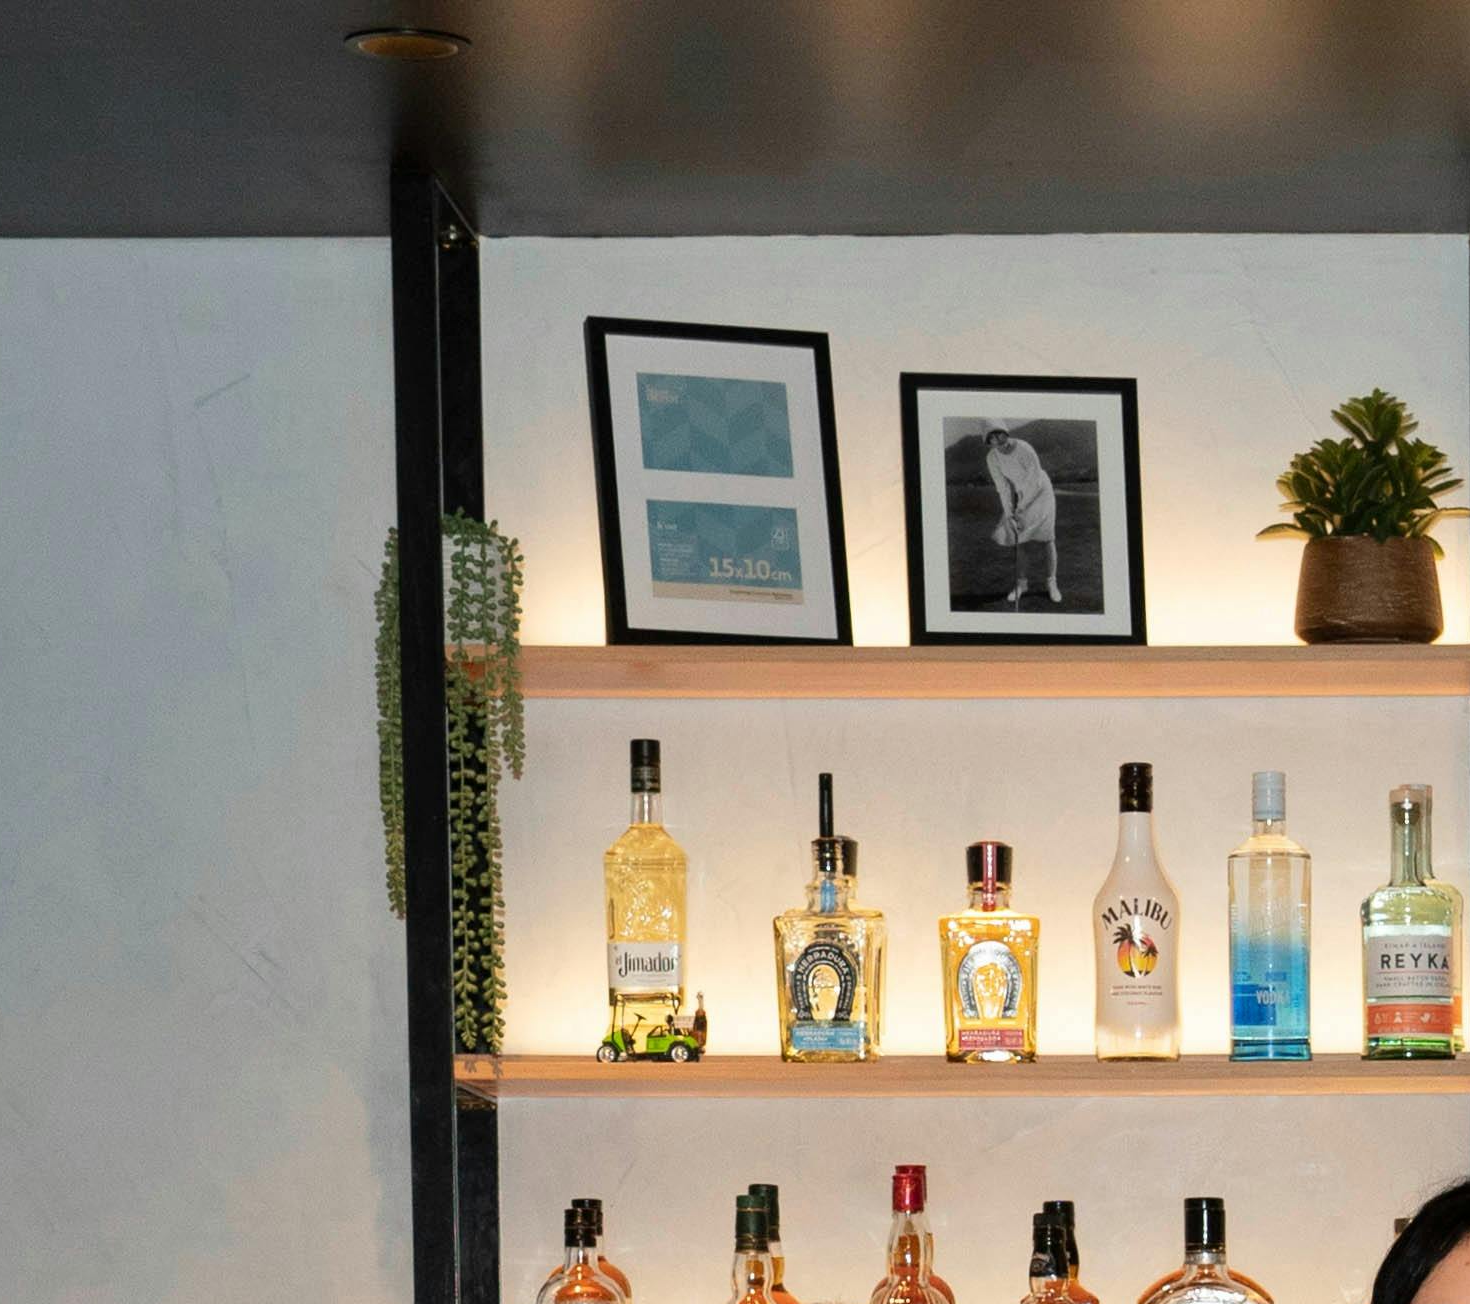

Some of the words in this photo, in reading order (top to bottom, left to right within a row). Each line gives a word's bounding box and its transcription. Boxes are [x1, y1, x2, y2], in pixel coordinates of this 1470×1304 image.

[709, 556, 793, 582] 15x10cm
[1101, 898, 1173, 932] MALIBU
[1380, 952, 1450, 970] REYKA
